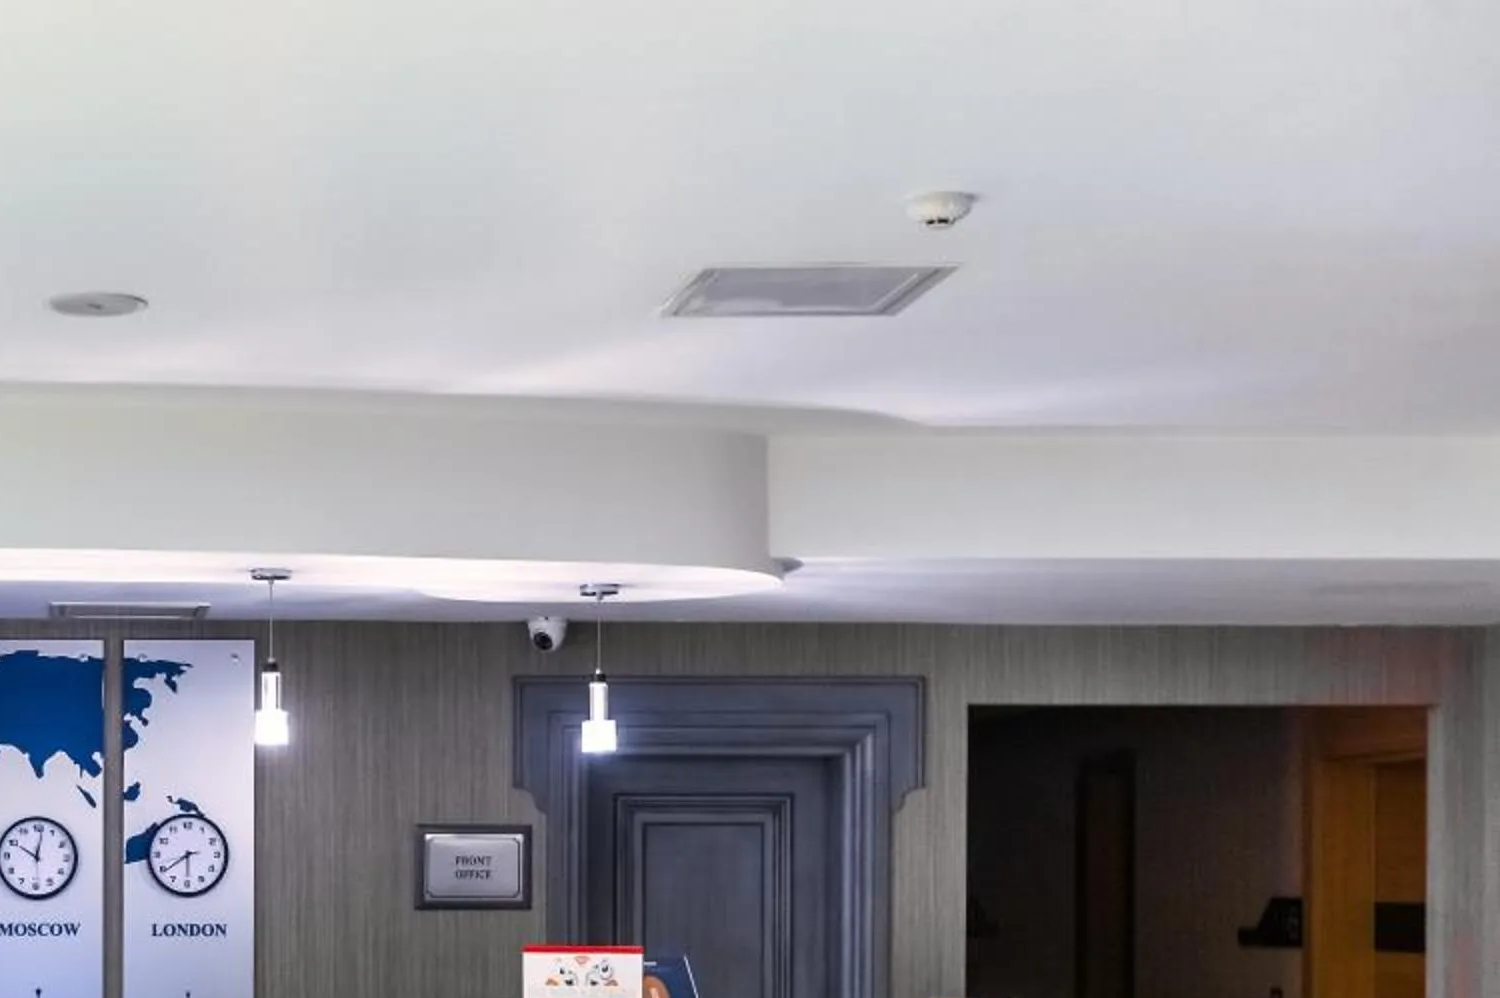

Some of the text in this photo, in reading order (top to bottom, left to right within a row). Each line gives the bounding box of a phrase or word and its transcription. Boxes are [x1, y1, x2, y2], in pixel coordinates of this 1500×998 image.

[455, 855, 492, 867] FRONT
[455, 869, 492, 881] OFFICE
[151, 923, 228, 937] LONDON
